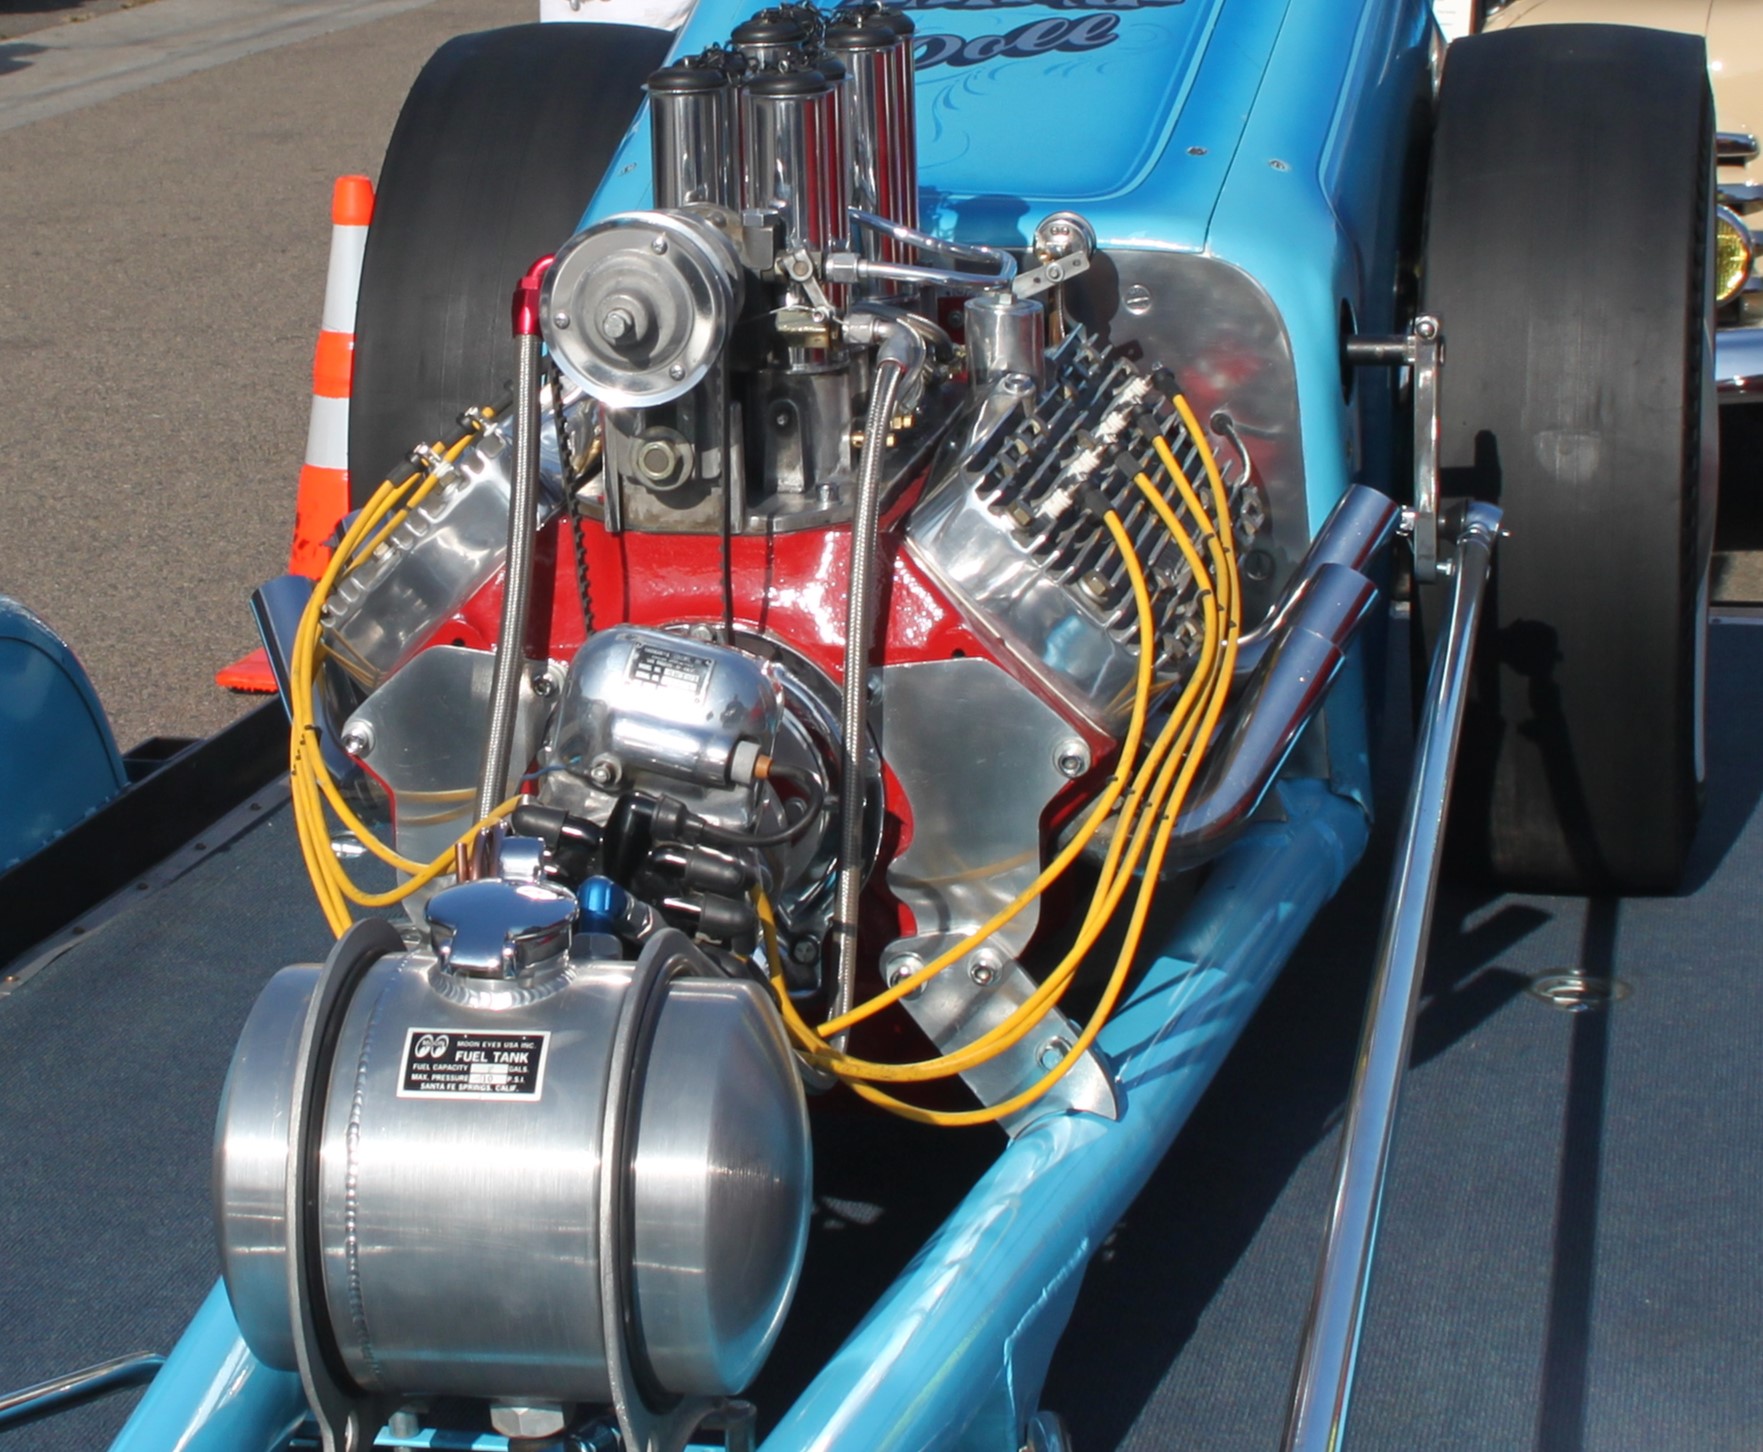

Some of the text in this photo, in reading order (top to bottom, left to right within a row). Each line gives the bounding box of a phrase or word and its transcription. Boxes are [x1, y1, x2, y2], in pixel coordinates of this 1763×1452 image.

[503, 1041, 519, 1049] USA
[455, 1051, 529, 1063] FUEL TANK
[412, 1063, 431, 1071] FUEL
[411, 1073, 430, 1081] MAX.
[431, 1074, 468, 1082] PRESSURE
[420, 1082, 445, 1090] SANTA
[446, 1083, 456, 1091] FE
[495, 1084, 519, 1092] CALIF.
